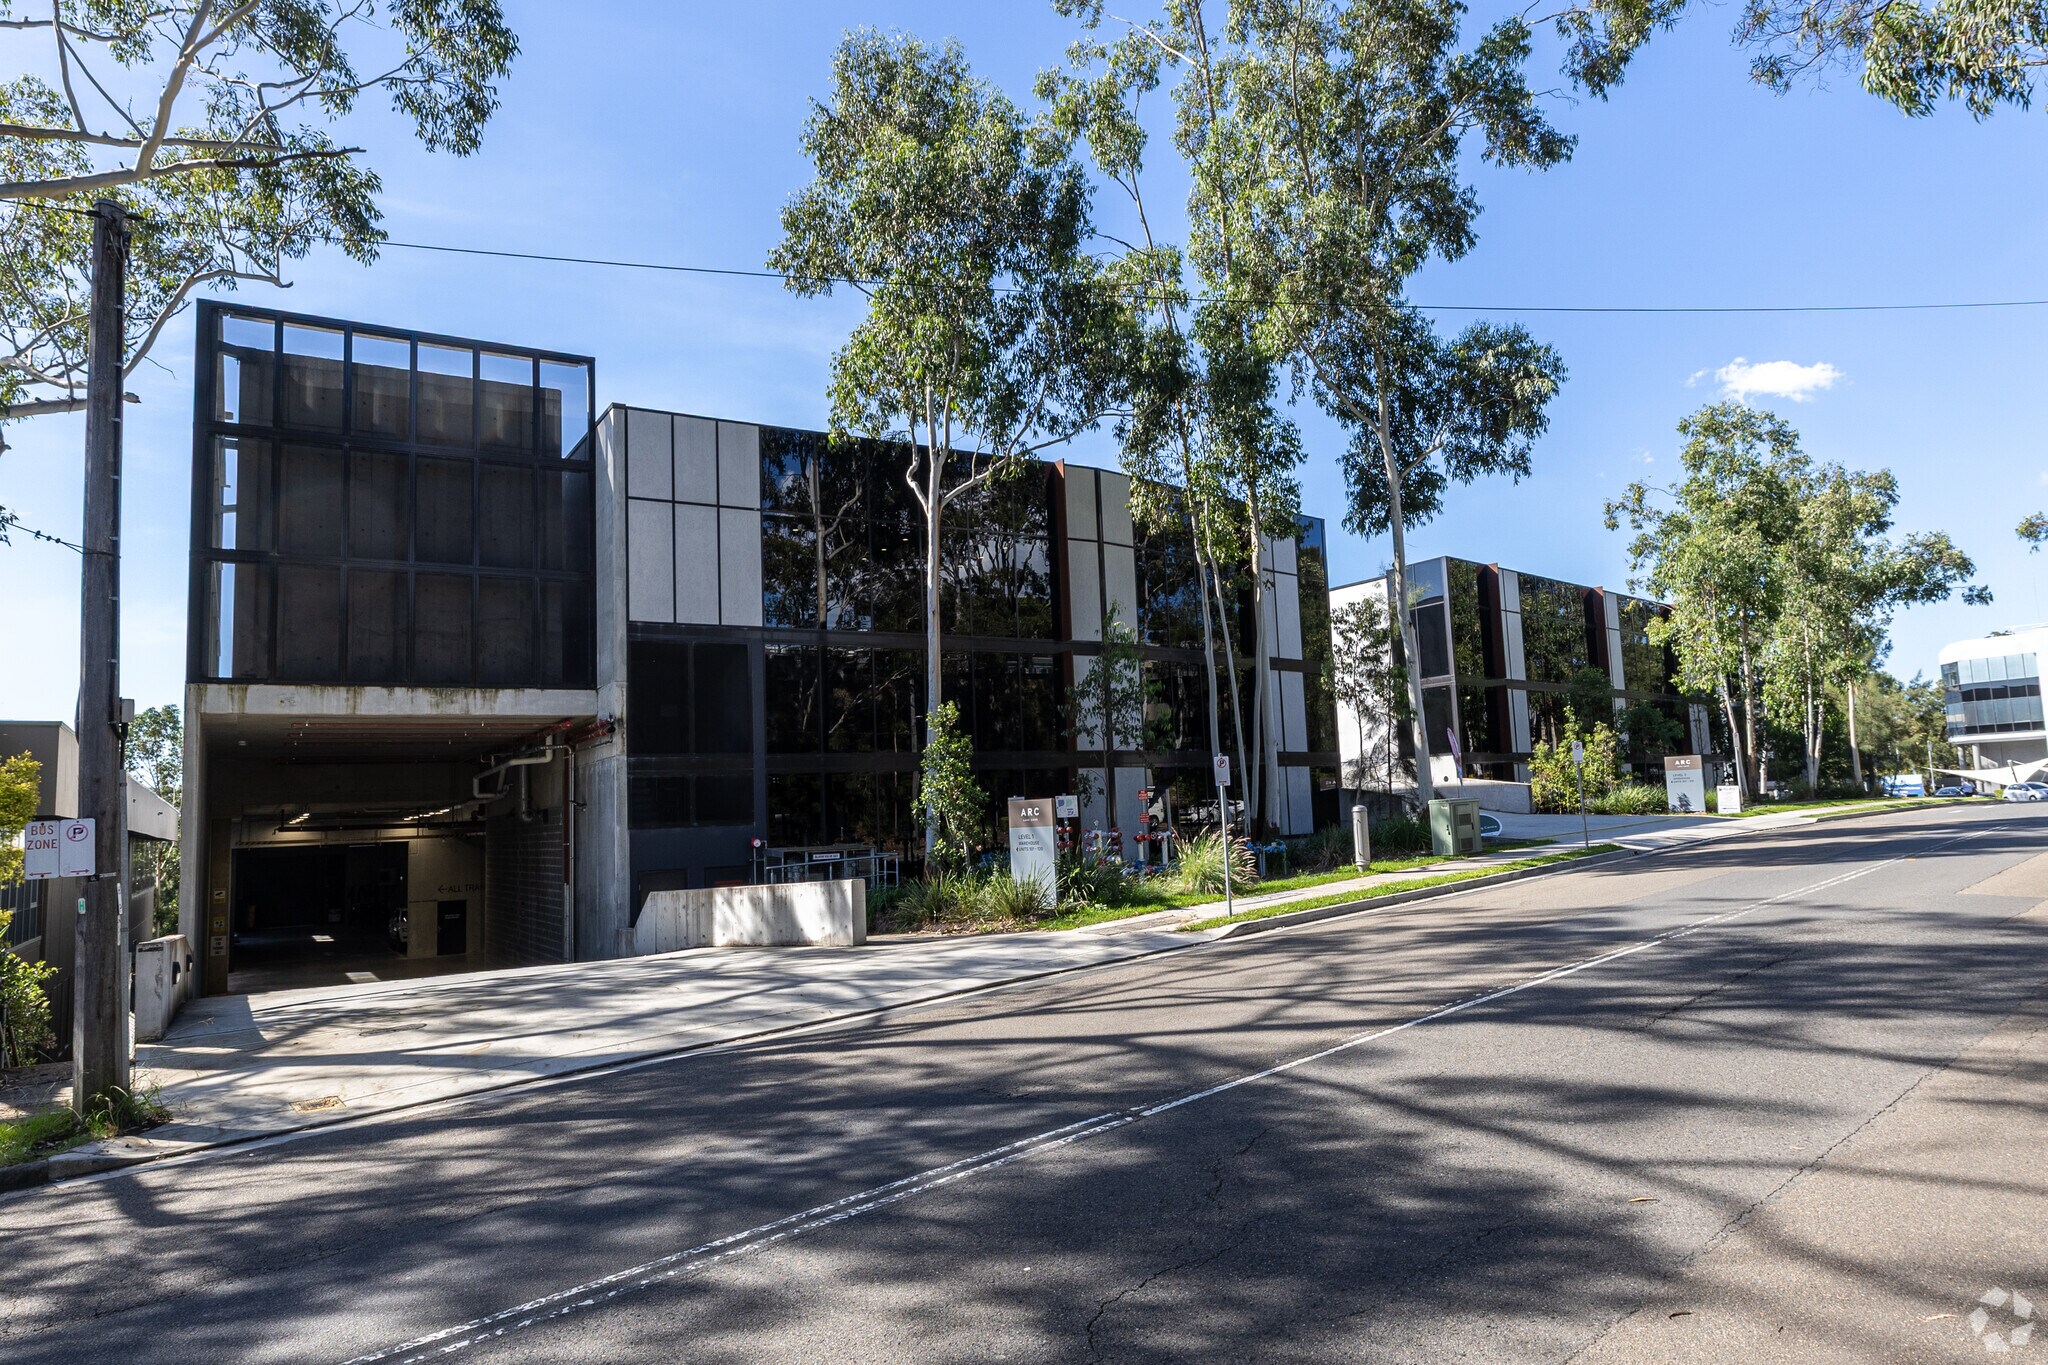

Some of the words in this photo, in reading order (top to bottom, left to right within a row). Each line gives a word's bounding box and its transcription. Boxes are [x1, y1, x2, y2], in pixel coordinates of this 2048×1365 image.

[1021, 807, 1040, 817] ARC
[31, 825, 54, 836] BUS
[73, 827, 84, 839] P
[27, 839, 58, 850] ZONE
[448, 884, 463, 893] ALL
